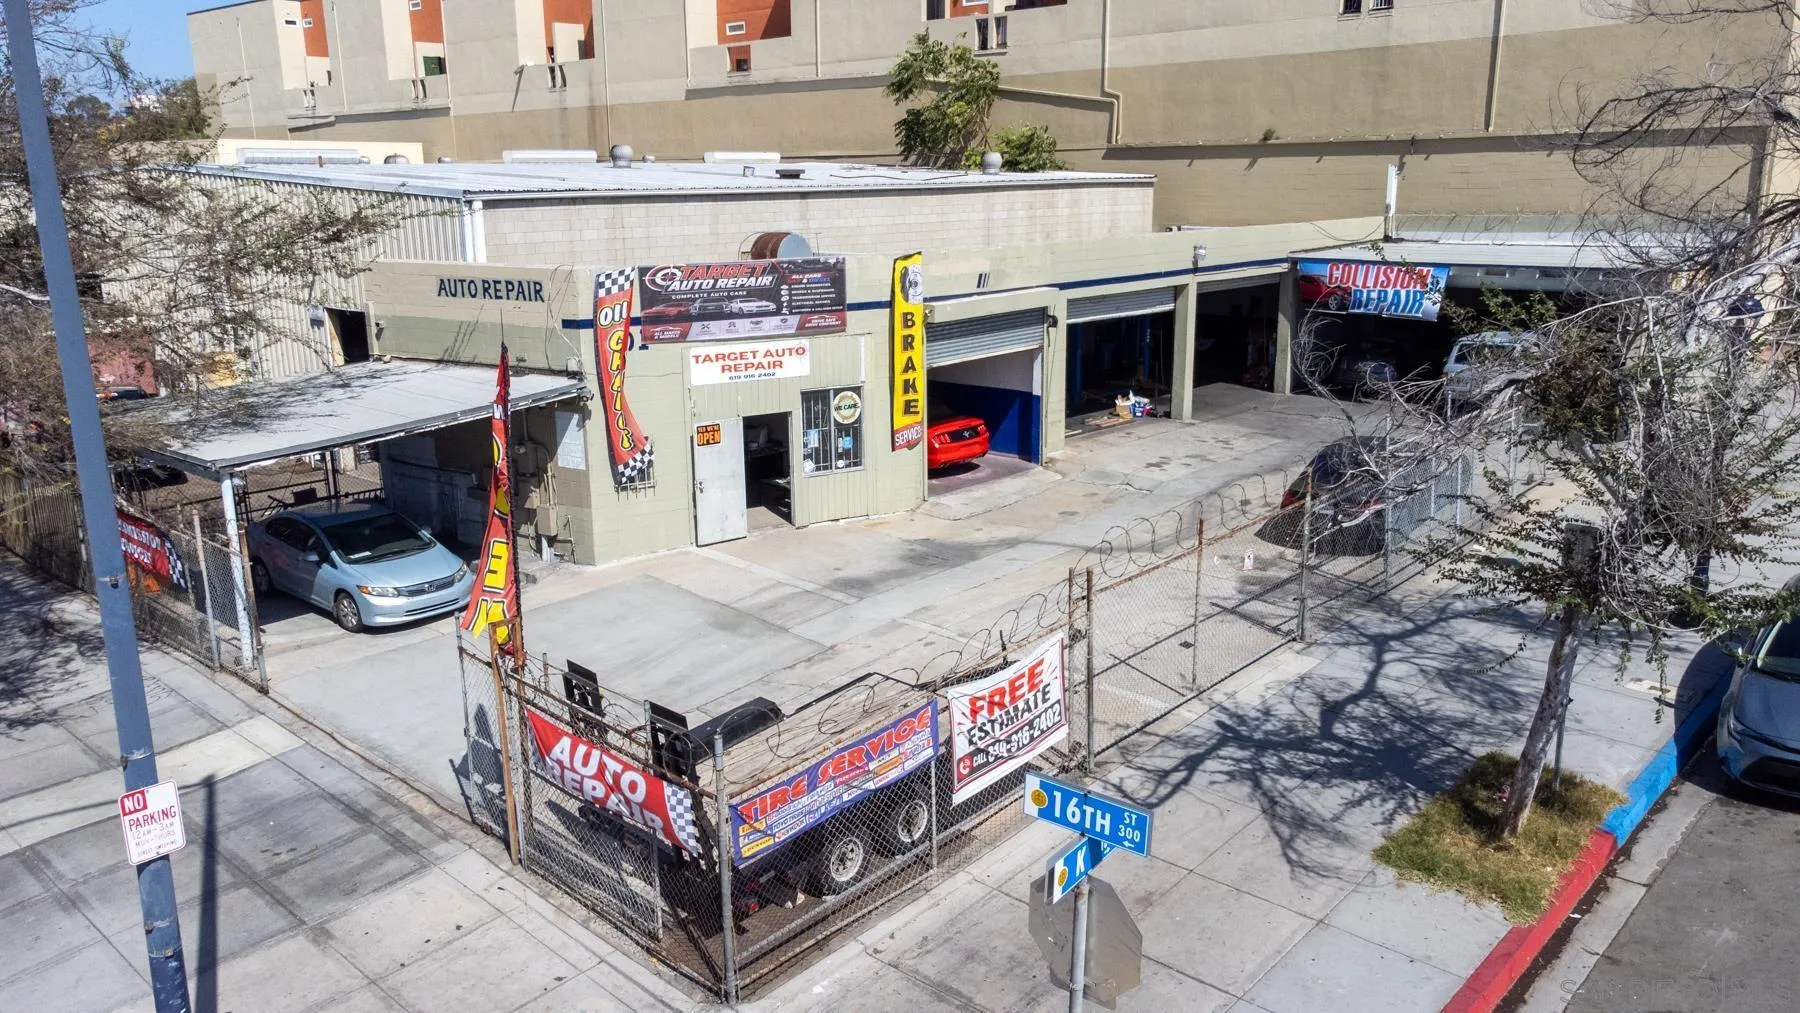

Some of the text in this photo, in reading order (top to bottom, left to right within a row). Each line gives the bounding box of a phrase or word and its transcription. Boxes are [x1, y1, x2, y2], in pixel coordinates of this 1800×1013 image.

[668, 278, 711, 292] AUTO
[713, 277, 773, 290] REPAIR
[680, 263, 768, 280] TARGET
[1327, 262, 1433, 290] COLLISION
[437, 278, 545, 303] AUTO REPAIR
[1351, 289, 1426, 315] REPAIR
[692, 346, 806, 364] TARGET AUTO
[721, 360, 784, 374] REPAIR
[901, 311, 920, 417] BRAKE
[698, 431, 720, 445] OPEN
[968, 658, 1044, 724] FREE
[967, 684, 1051, 747] ESTIMATE
[549, 736, 647, 803] AUTO
[738, 706, 932, 824] TIRE SERVICE
[972, 752, 987, 768] CALL
[123, 793, 144, 814] NO
[545, 758, 667, 839] REPAIR
[128, 805, 177, 832] PARKING
[1053, 790, 1111, 836] 16TH
[1124, 812, 1138, 826] ST
[1118, 825, 1141, 842] 300
[1075, 845, 1087, 877] K
